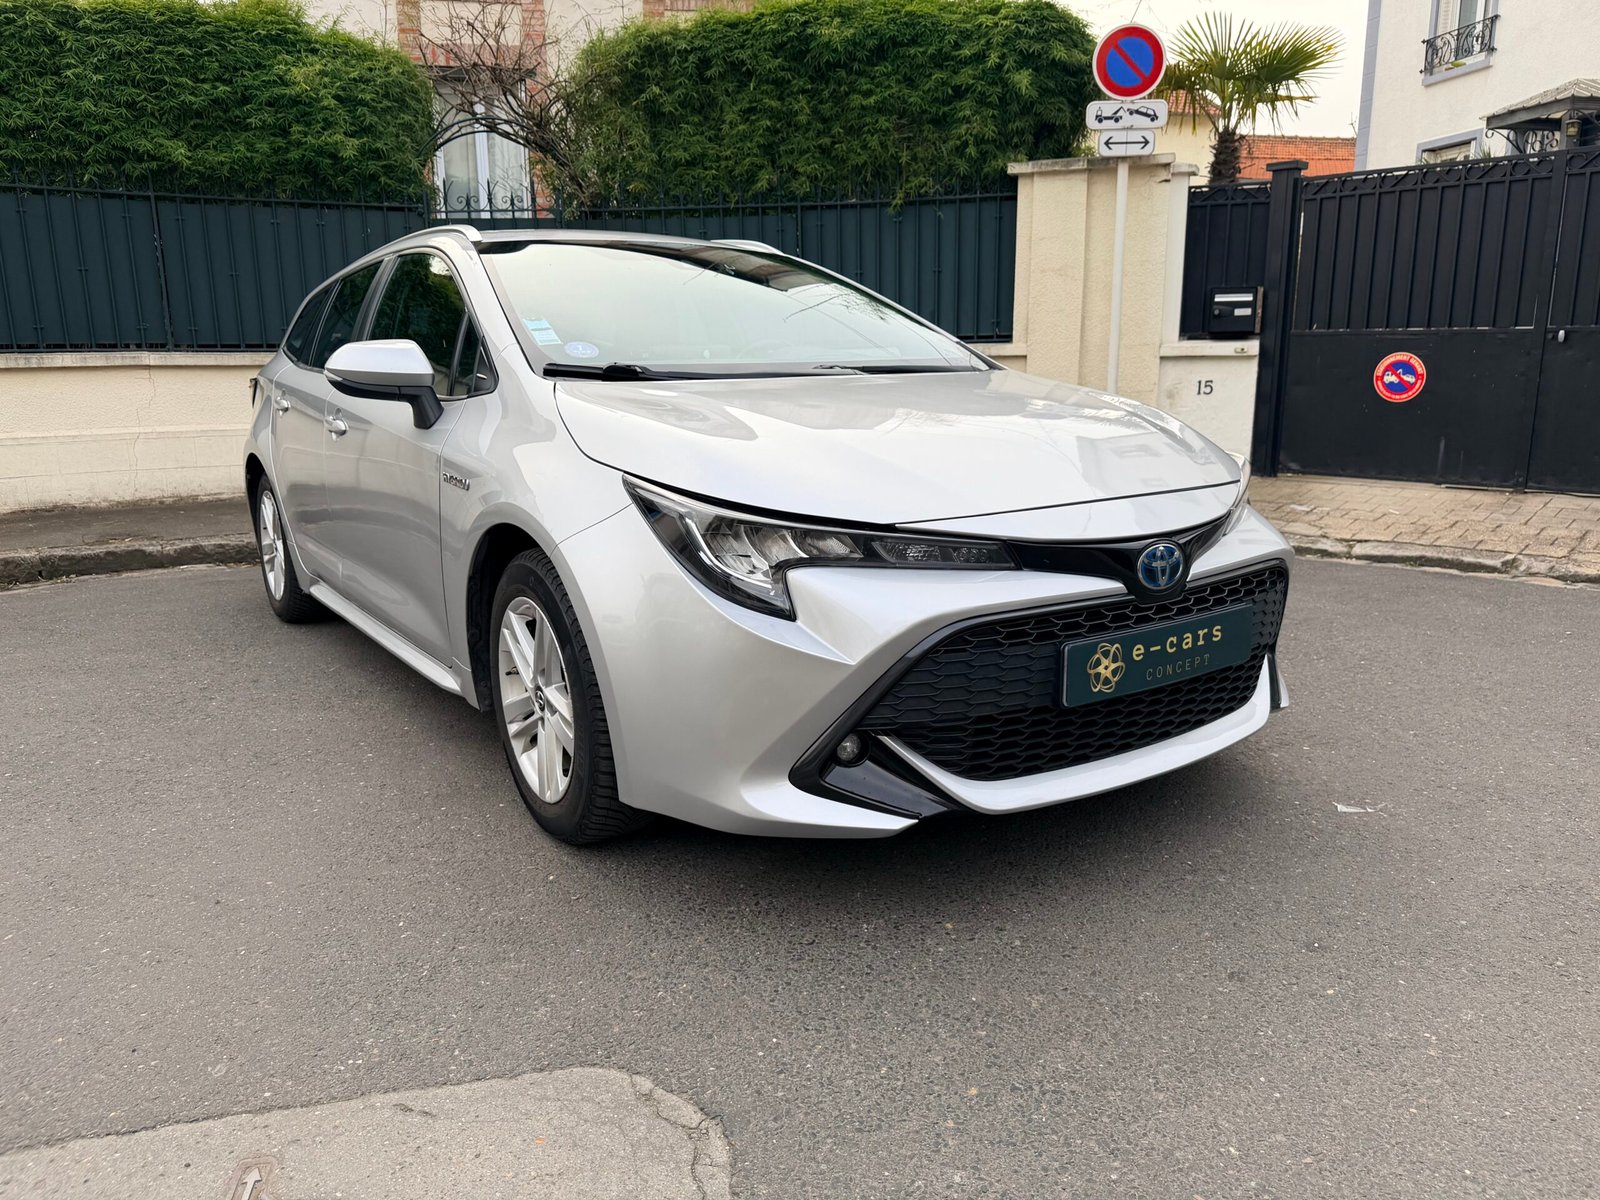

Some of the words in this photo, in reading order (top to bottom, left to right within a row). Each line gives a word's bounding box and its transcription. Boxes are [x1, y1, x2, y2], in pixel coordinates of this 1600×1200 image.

[1376, 354, 1411, 377] STEMENT
[1196, 379, 1214, 396] 15
[1131, 624, 1223, 662] e-cars
[1145, 653, 1211, 681] CONCEPT
